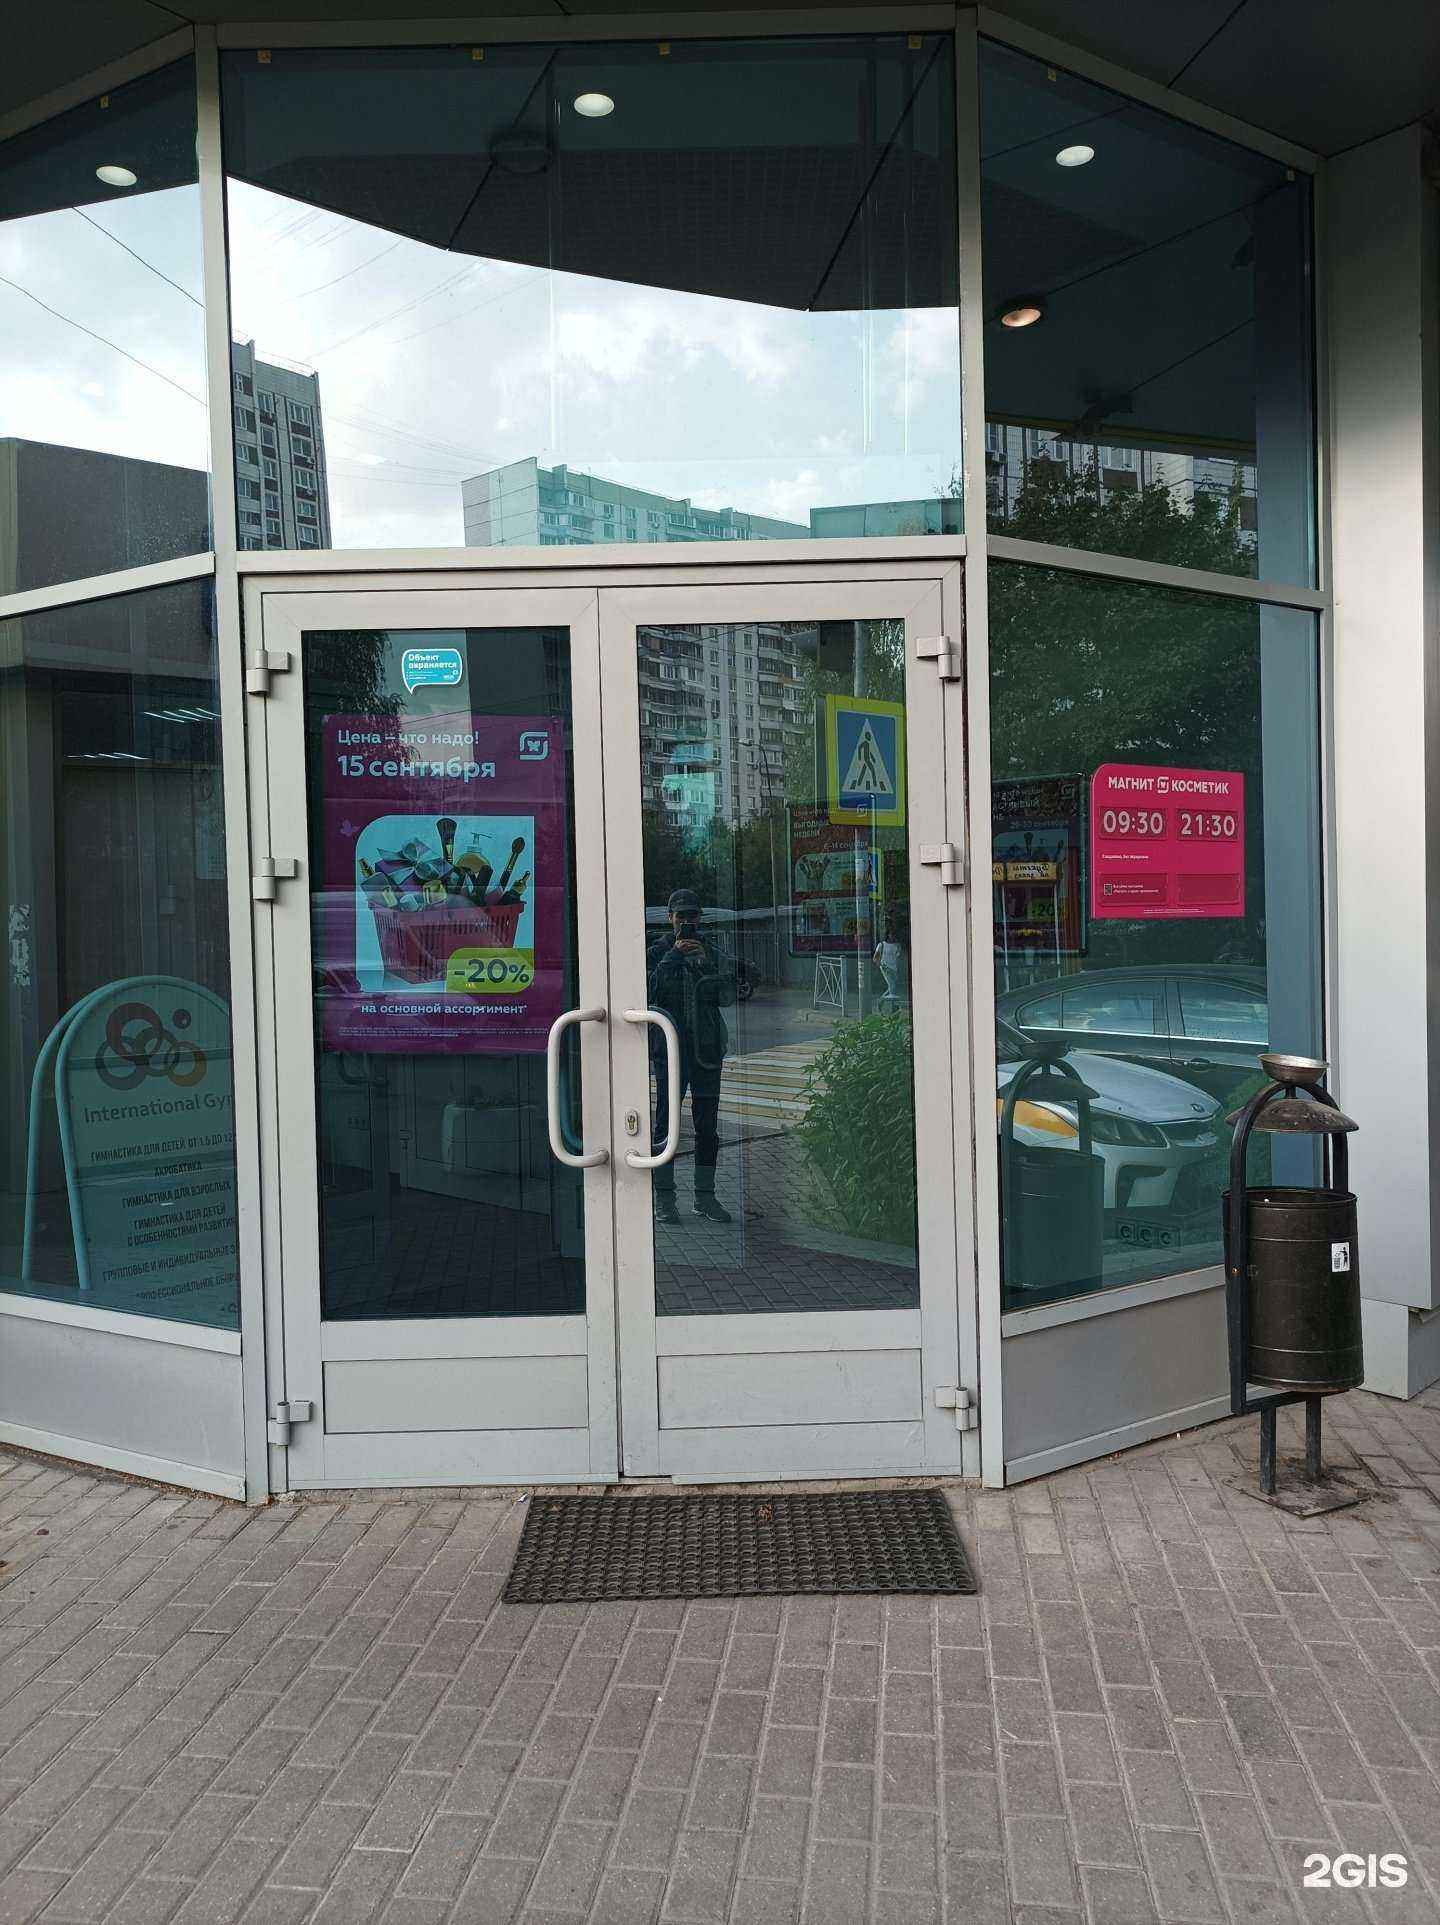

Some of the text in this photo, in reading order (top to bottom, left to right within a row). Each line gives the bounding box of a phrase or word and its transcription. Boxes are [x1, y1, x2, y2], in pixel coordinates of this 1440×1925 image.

[408, 653, 440, 662] Объект
[408, 662, 457, 671] охраняется
[337, 729, 382, 746] Цена
[399, 732, 428, 745] что
[431, 731, 480, 748] надо!
[336, 754, 497, 783] 15 сентября
[1108, 776, 1230, 795] МАГНИТ КОСМЕТИК
[1103, 810, 1236, 837] 09:30 21:30
[454, 958, 530, 984] -20%
[361, 1004, 377, 1014] на
[380, 1002, 441, 1014] основной
[83, 1093, 201, 1124] International
[90, 1143, 144, 1162] ГИМНАСТИКА
[154, 1160, 203, 1177] АКРОБАТИКА
[121, 1180, 232, 1209] ГИМНАСТИКА ДЛЯ ВЗРОСЛЫХ
[133, 1201, 226, 1231] ГИМНАСТИКА ДЛЯ ДЕТЕЙ
[134, 1224, 198, 1246] ОСОБЕННОСТЯМИ
[102, 1261, 150, 1283] ГРУППОВЫЕ
